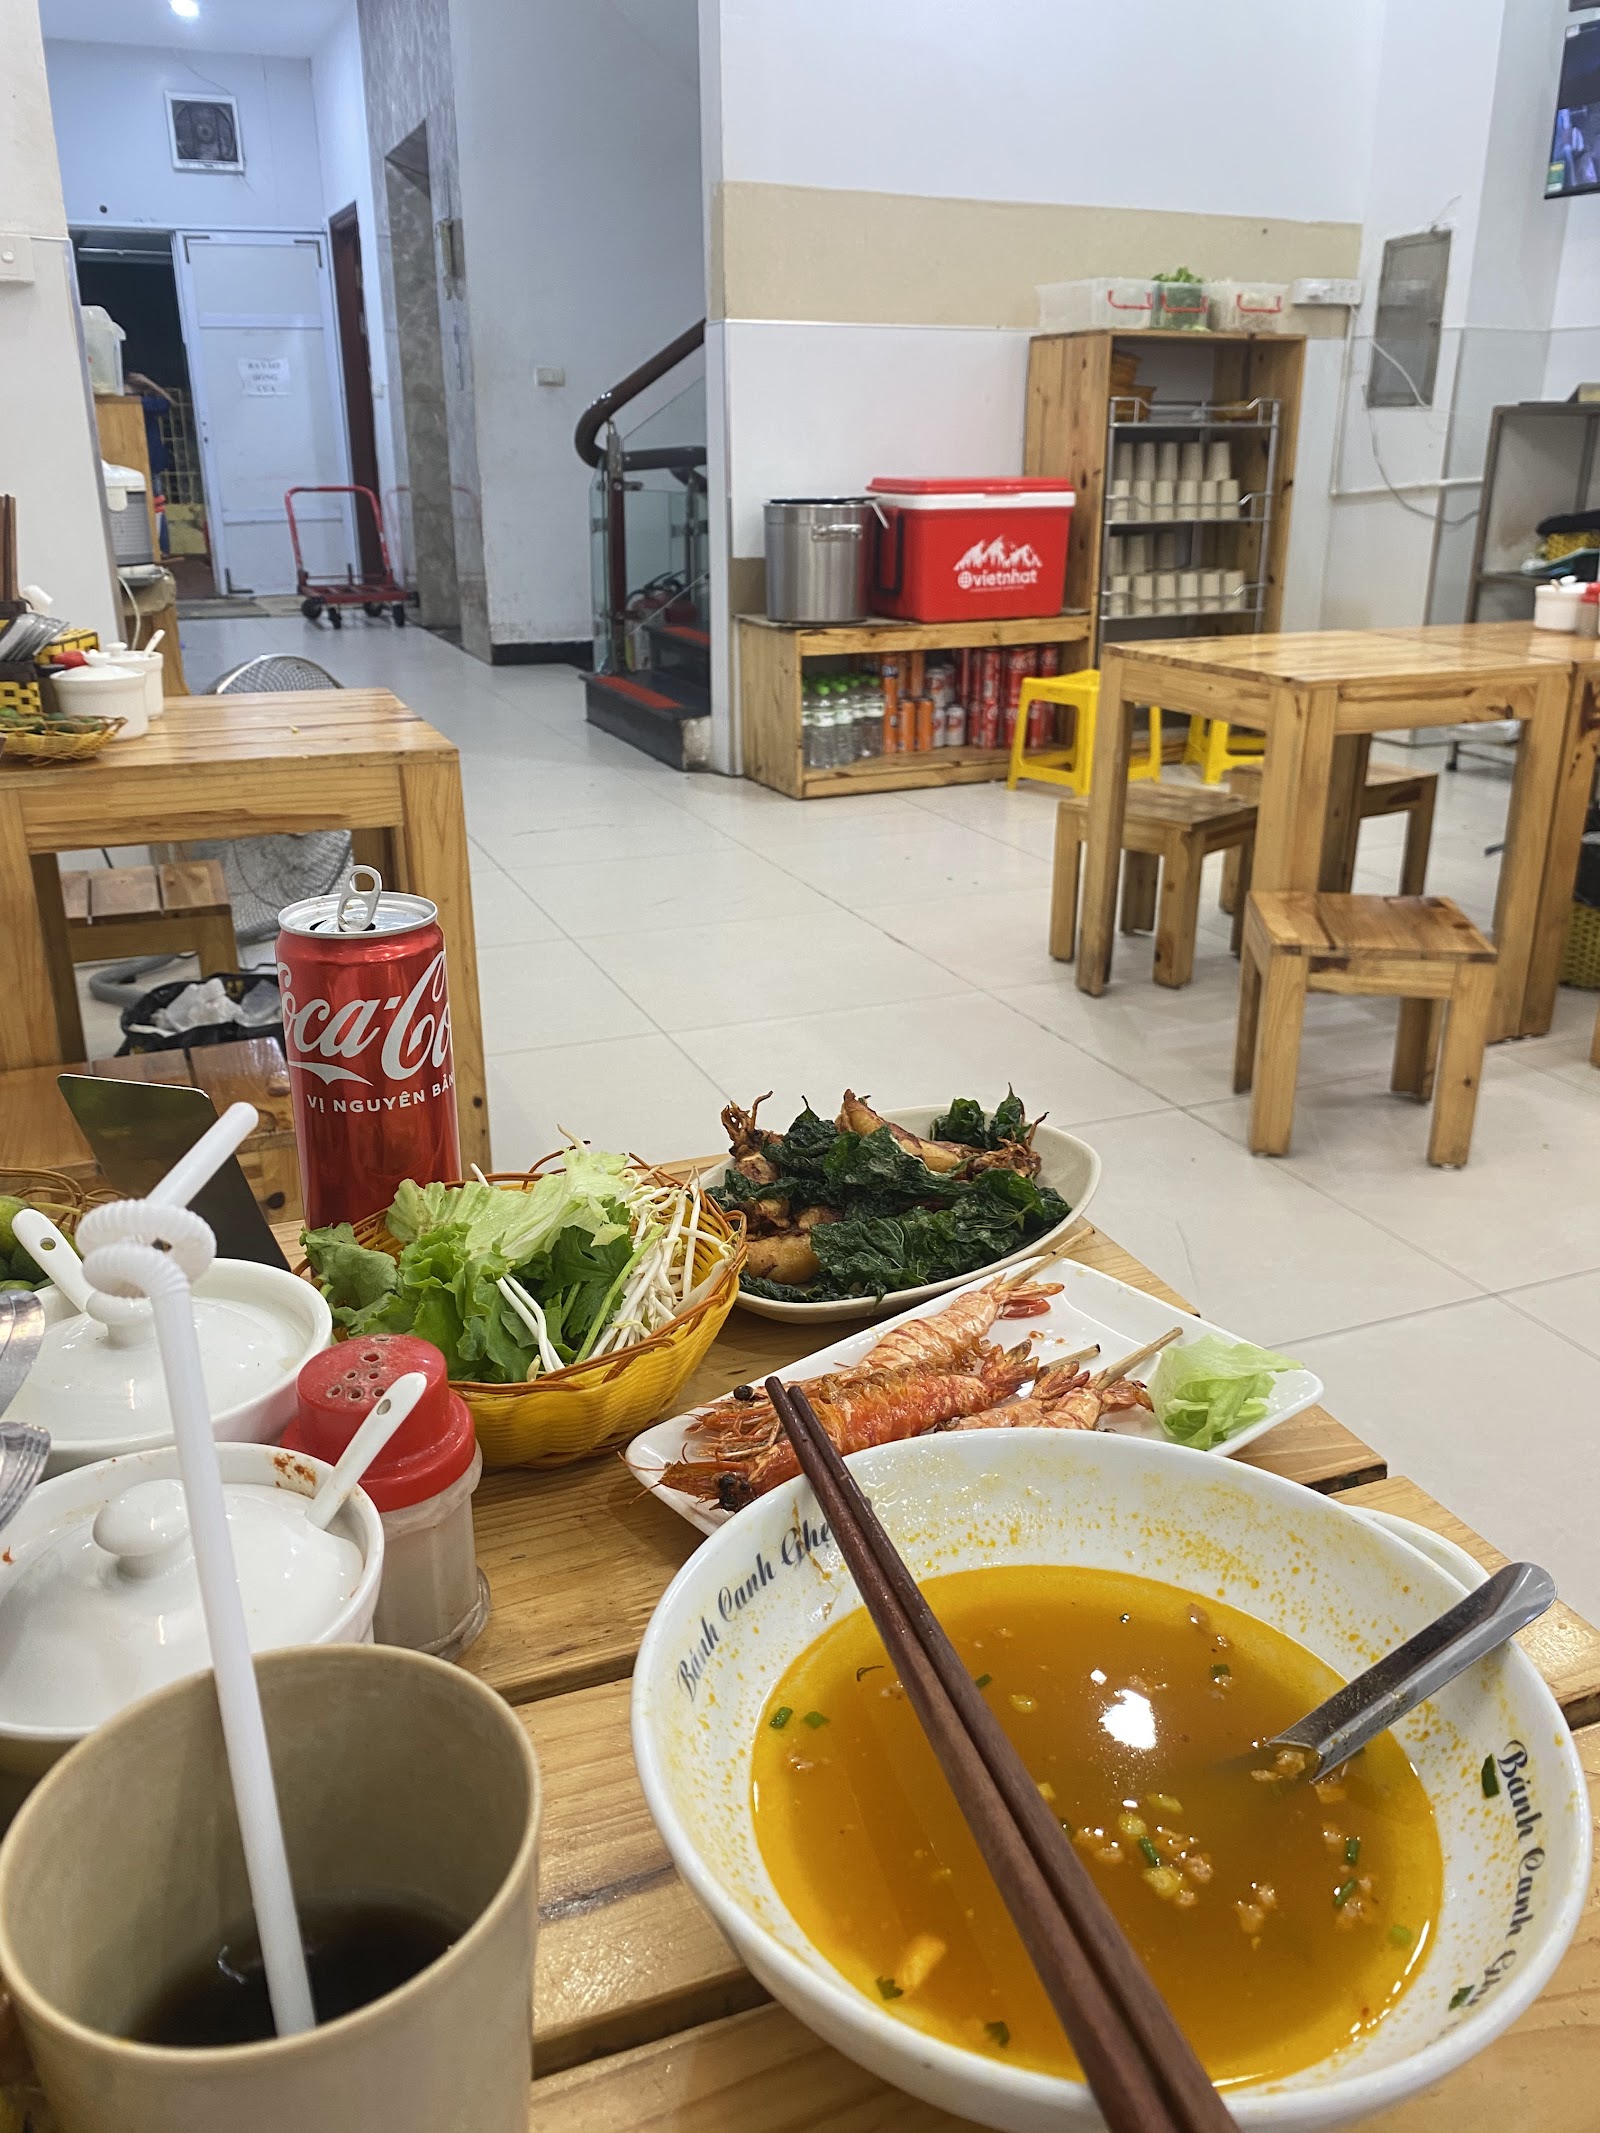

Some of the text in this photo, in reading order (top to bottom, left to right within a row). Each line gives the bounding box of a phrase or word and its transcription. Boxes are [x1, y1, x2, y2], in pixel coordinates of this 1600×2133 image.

[972, 568, 1038, 587] vietnhat
[307, 1094, 325, 1113] VỊ
[333, 1089, 425, 1113] NGUYÊN
[676, 1616, 720, 1703] Bánh
[717, 1552, 776, 1622] Canh
[1497, 1739, 1543, 1845] Bánh
